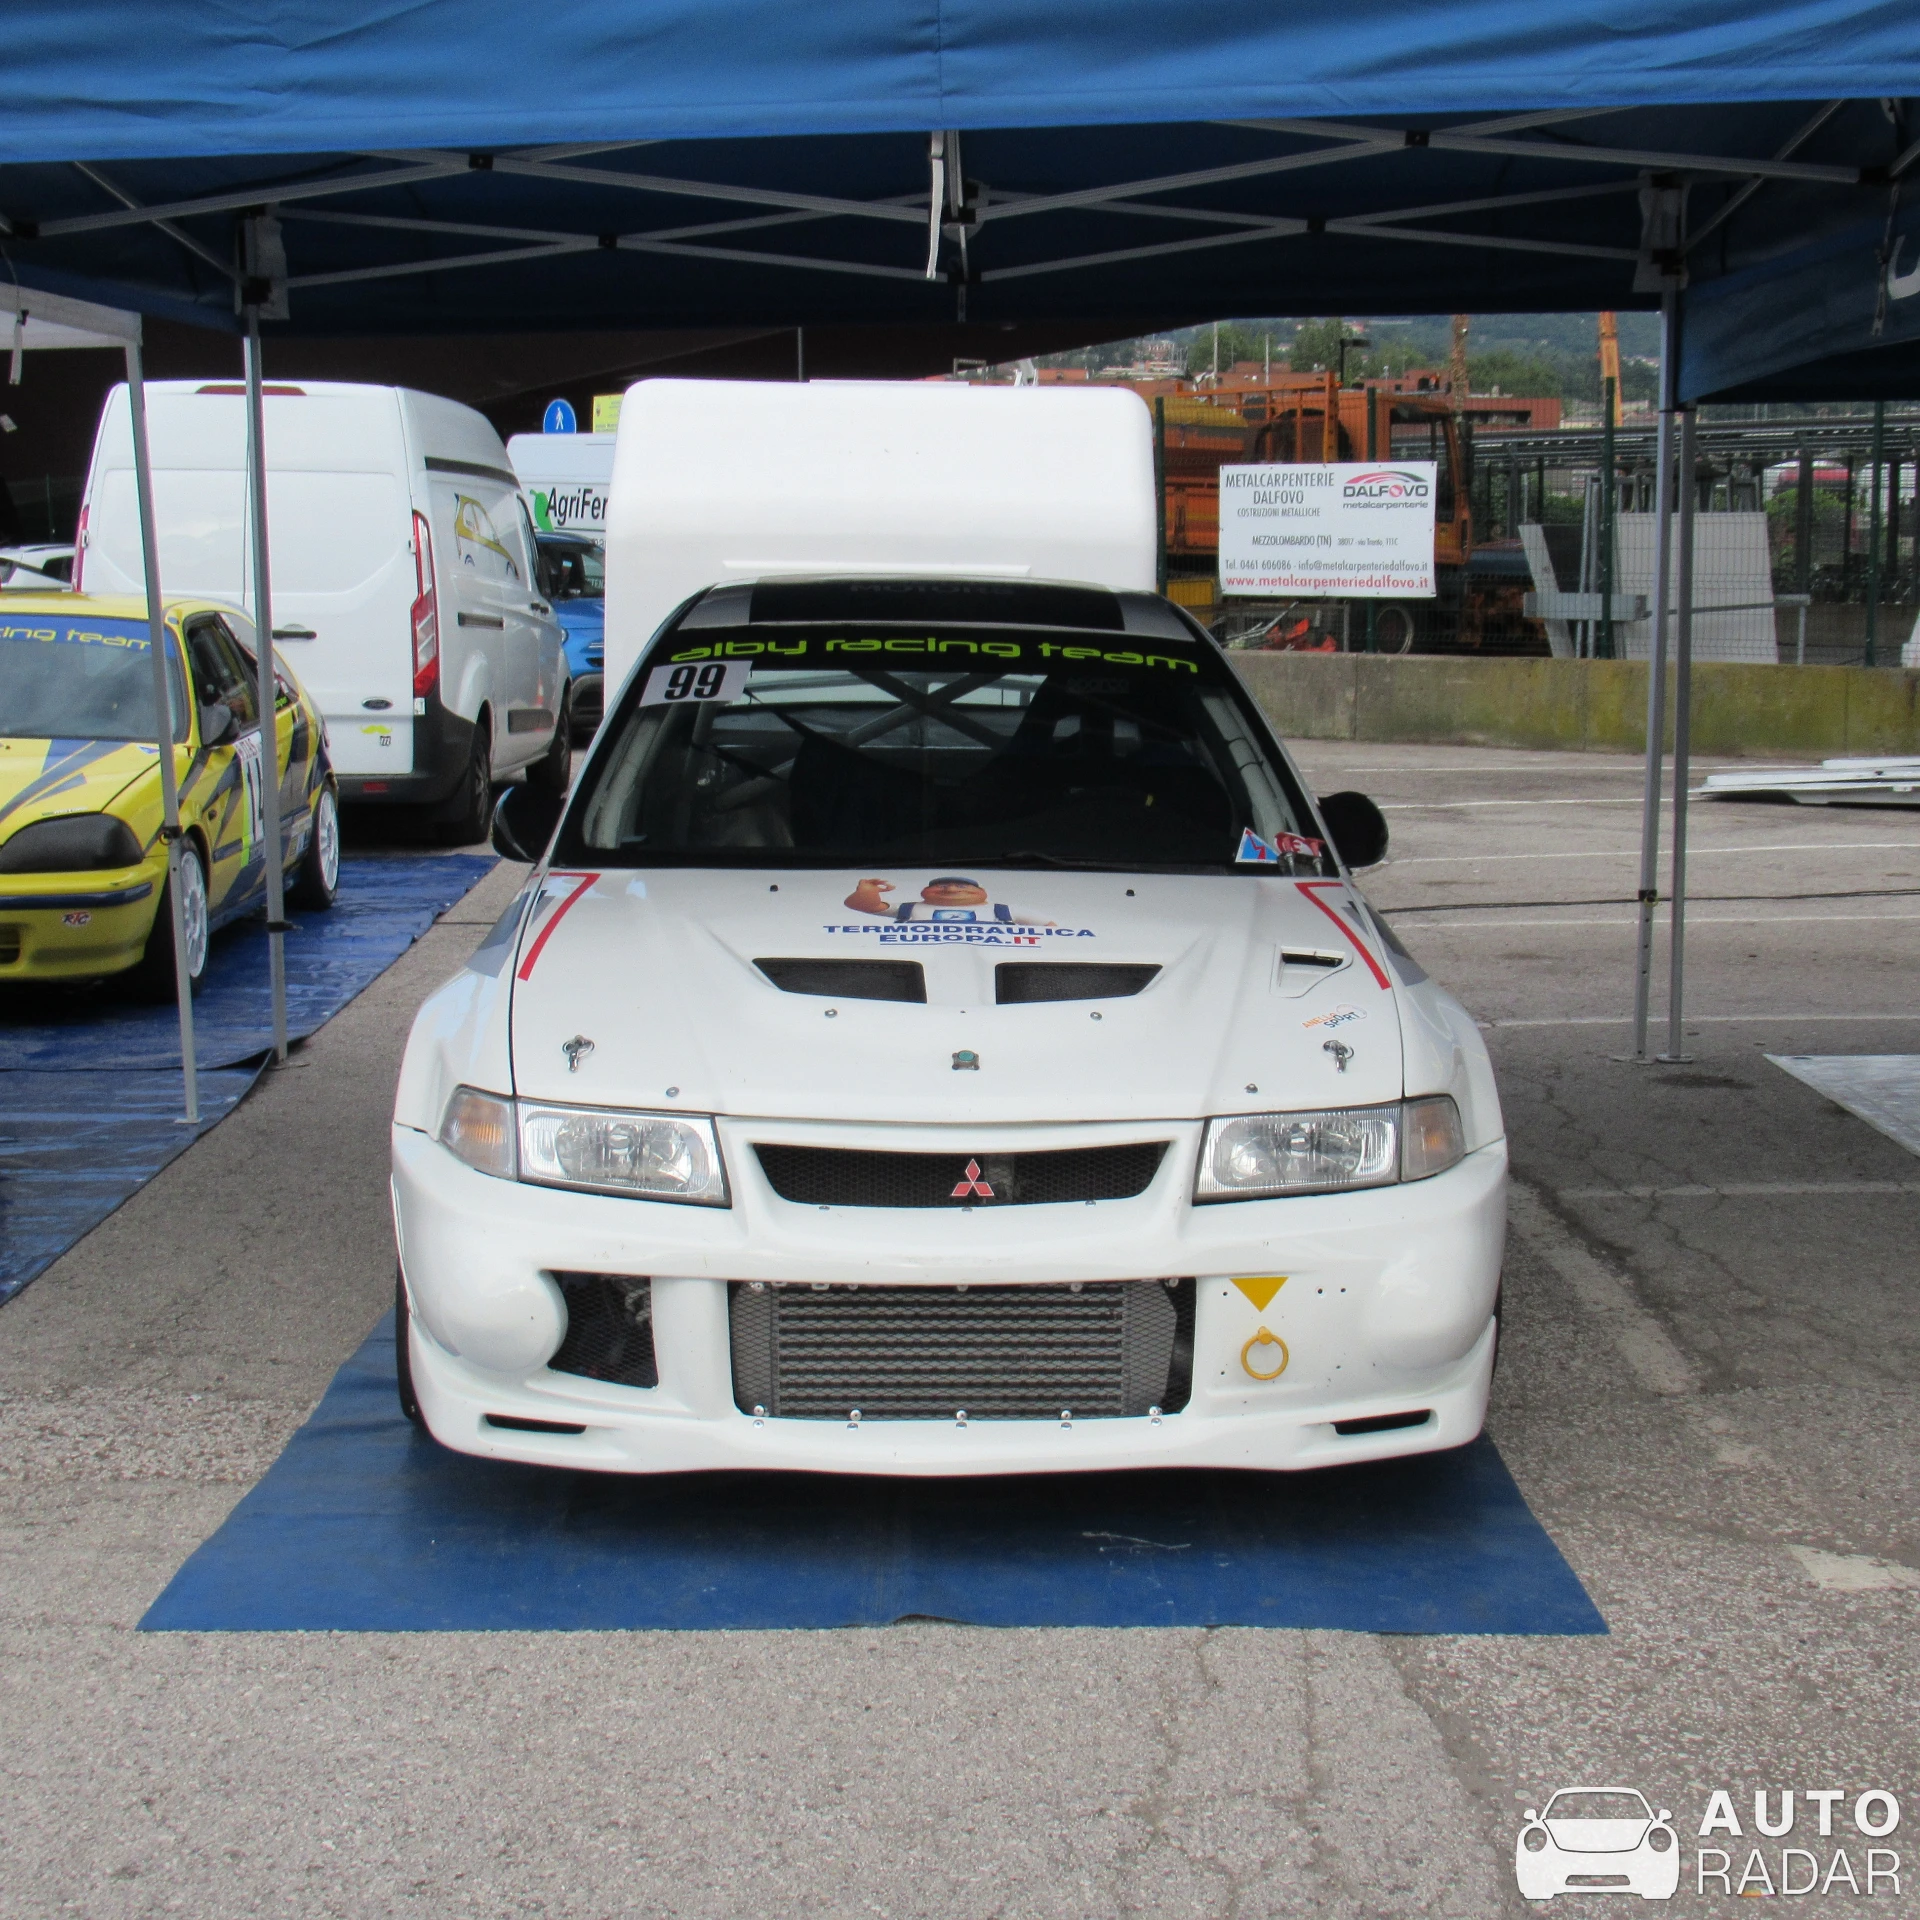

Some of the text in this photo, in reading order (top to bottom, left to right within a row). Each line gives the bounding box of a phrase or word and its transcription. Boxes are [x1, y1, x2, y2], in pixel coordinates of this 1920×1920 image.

[1226, 472, 1335, 488] METALCARPENTERIE
[1253, 490, 1304, 505] DALFOVO
[1343, 484, 1429, 498] DALFOVO
[545, 487, 609, 526] AgriFer
[1343, 500, 1429, 510] metalcarpenterie
[1237, 507, 1321, 518] COSTRUZIONI METALLICHE
[1252, 535, 1315, 546] MEZZOLOMBARDO
[1316, 534, 1332, 548] (TN)
[1240, 560, 1259, 570] 0461
[1261, 560, 1292, 570] 606086
[1298, 559, 1428, 573] info@metalcarpenteriedalfovo.it
[1226, 574, 1428, 590] www.metalcarpenteriedalfovo.it
[671, 637, 1199, 673] alby racing team
[664, 663, 728, 700] 99
[823, 924, 1097, 938] TERMOIDRAULICA
[879, 934, 1042, 946] EUROPA.IT
